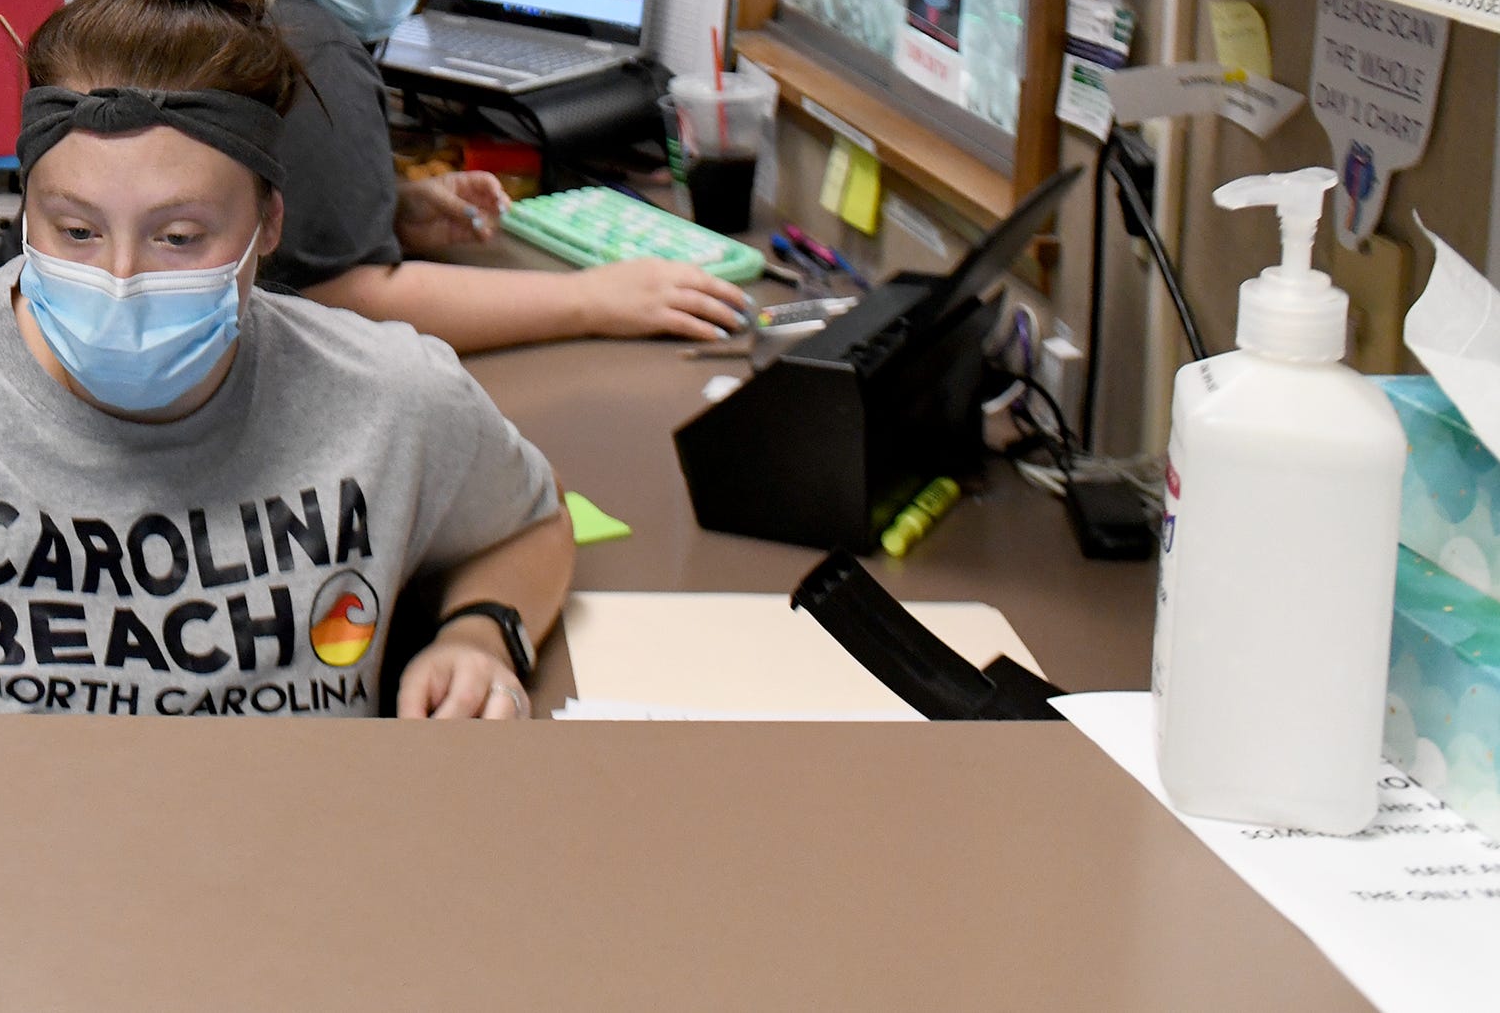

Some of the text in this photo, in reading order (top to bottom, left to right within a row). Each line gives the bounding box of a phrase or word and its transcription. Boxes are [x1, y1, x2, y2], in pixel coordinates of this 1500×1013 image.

[1386, 9, 1436, 48] SCAN
[1324, 36, 1426, 97] THE WHOLE
[1315, 81, 1347, 115] DAY
[1363, 102, 1423, 143] CHART
[155, 675, 369, 716] CAROLINA
[1350, 889, 1402, 901] THE
